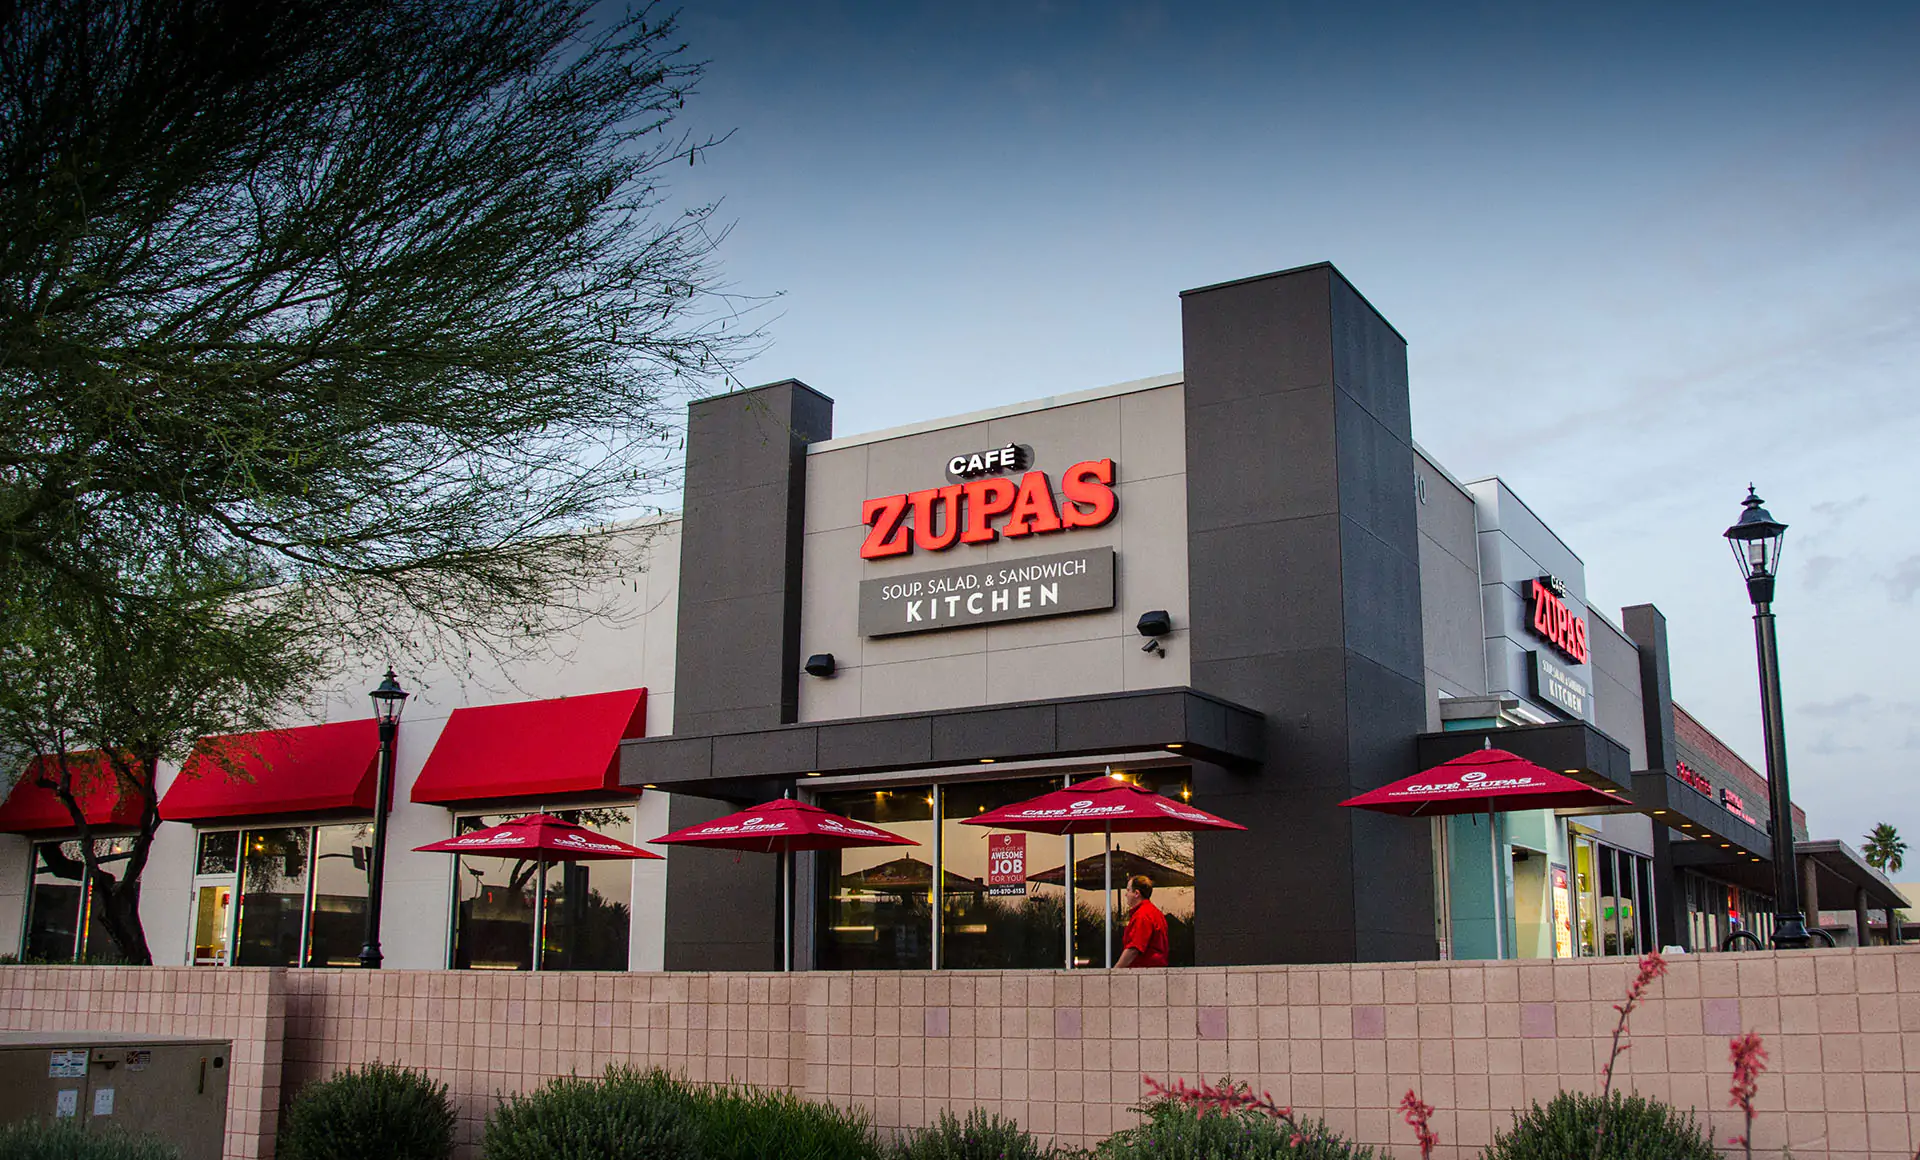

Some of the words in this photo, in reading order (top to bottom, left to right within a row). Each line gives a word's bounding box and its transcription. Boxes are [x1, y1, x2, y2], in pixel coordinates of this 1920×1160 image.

[949, 443, 1015, 475] CAFÉ
[860, 458, 1117, 559] ZUPAS
[928, 574, 980, 595] SALAD,
[985, 574, 994, 587] &
[999, 559, 1086, 585] SANDWICH
[906, 583, 1059, 623] KITCHEN
[1532, 578, 1587, 665] ZUPAS
[1549, 679, 1582, 714] KITCHEN
[1466, 777, 1532, 788] ZUPAS
[991, 851, 1023, 860] AWESOME
[991, 859, 1023, 875] JOB
[991, 875, 1005, 883] FOR
[1007, 874, 1024, 882] YOU!
